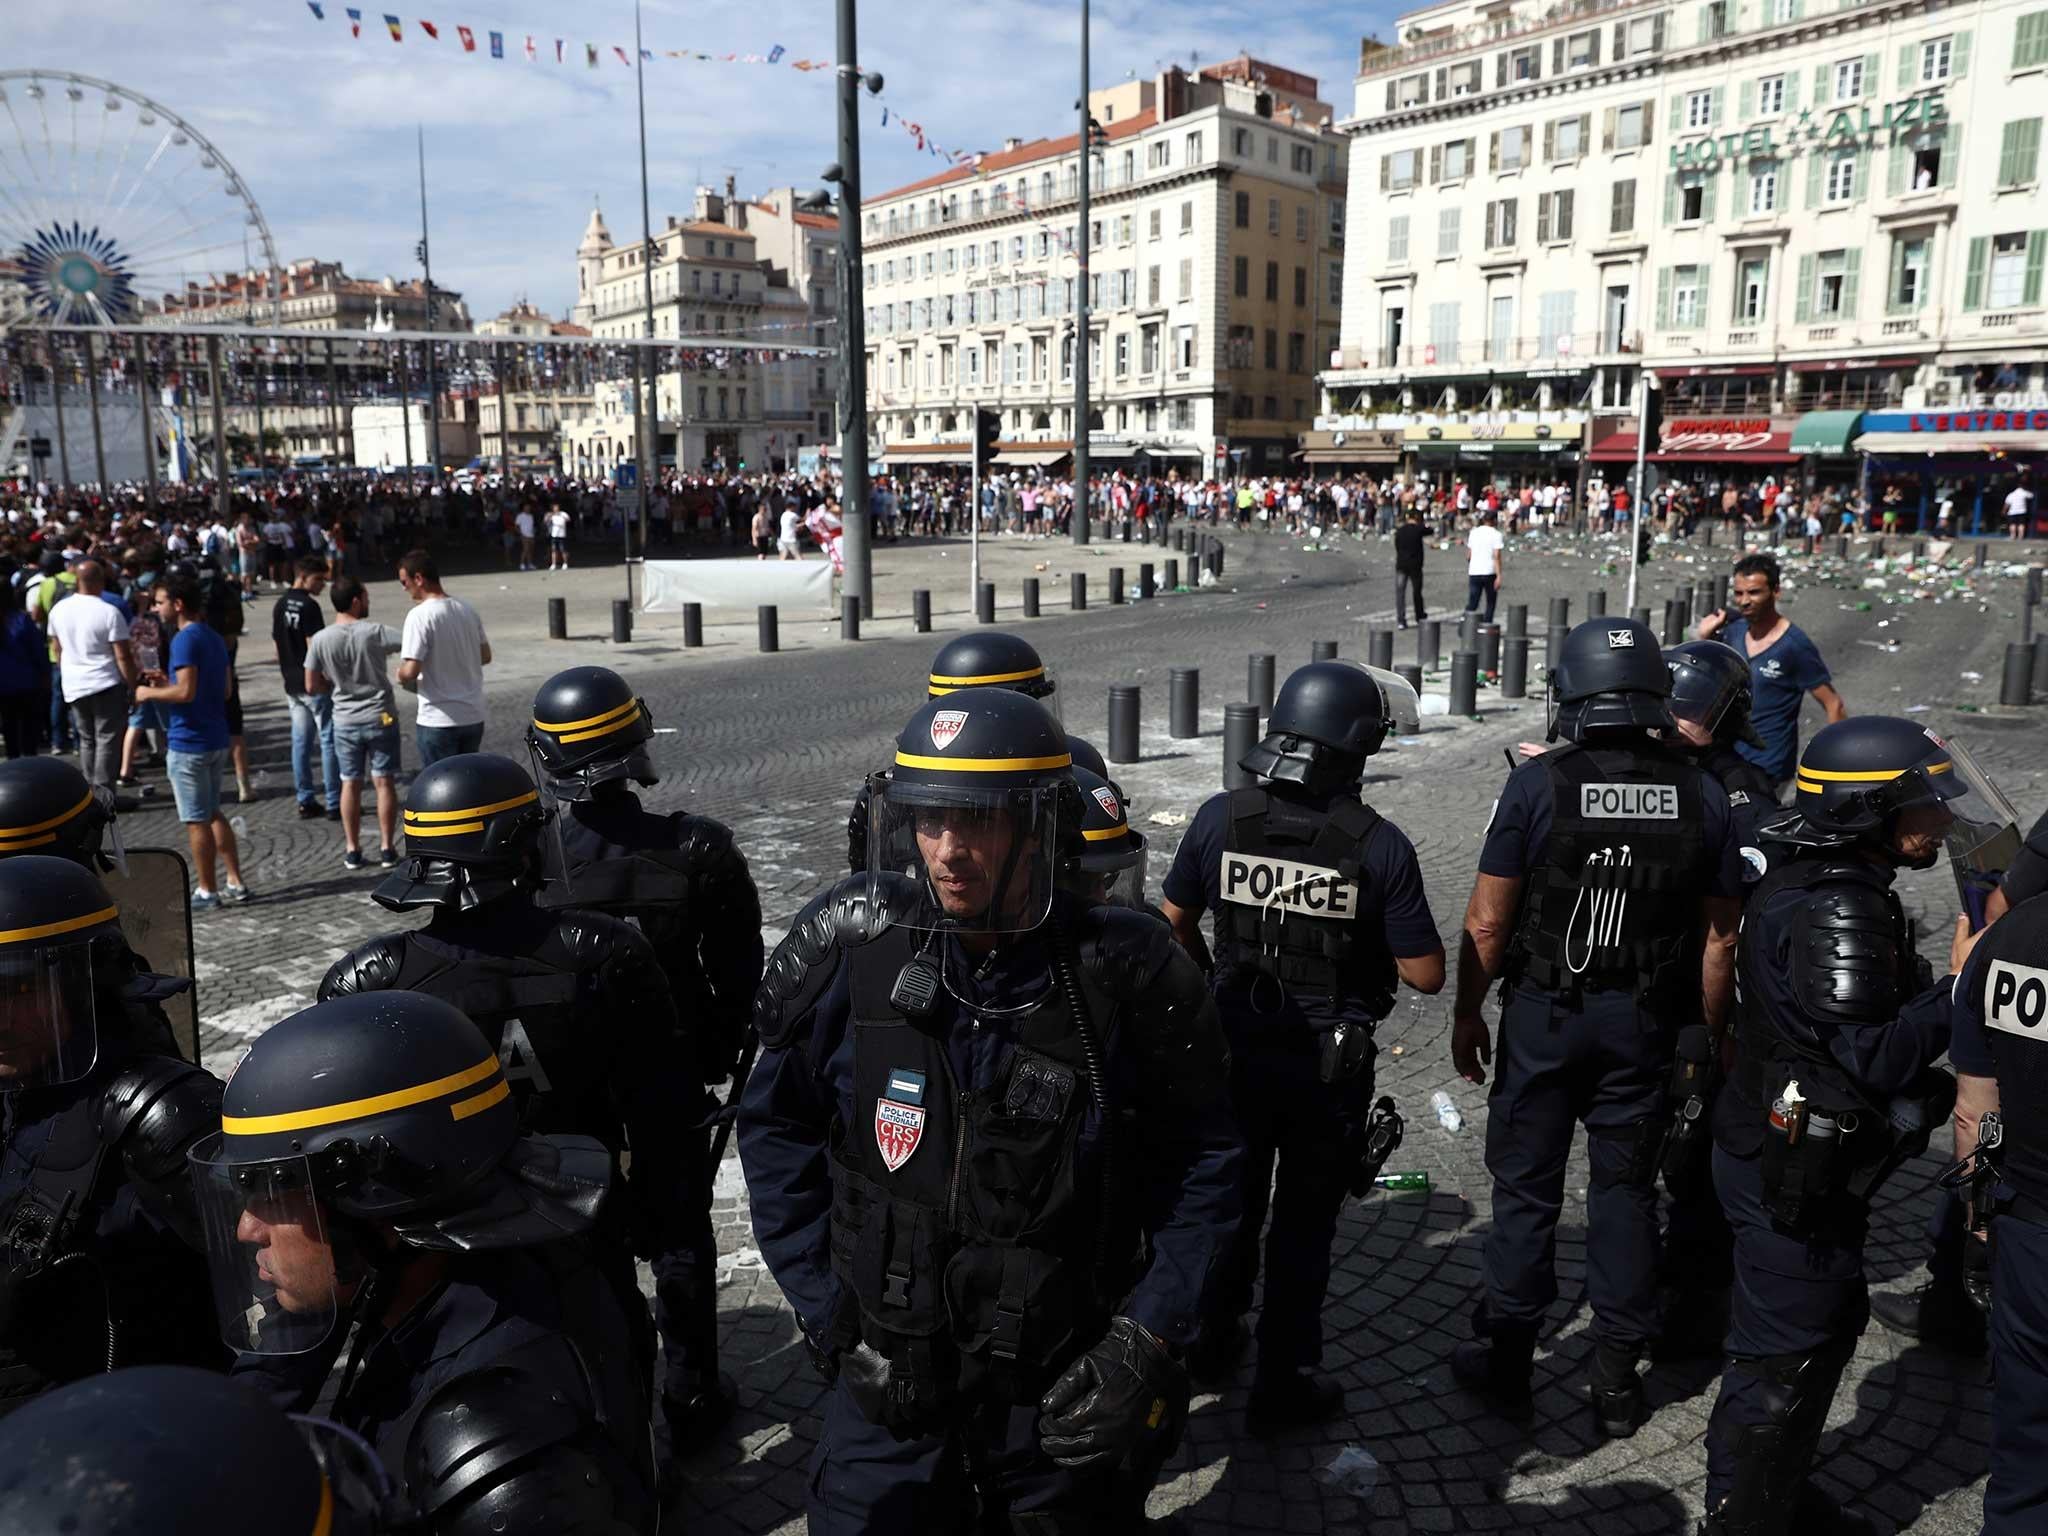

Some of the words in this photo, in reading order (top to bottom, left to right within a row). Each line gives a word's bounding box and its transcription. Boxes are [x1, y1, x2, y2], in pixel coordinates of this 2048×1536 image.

[1670, 127, 1780, 167] HOTEL
[934, 721, 958, 731] CRS
[1586, 788, 1674, 815] POLICE
[1227, 860, 1351, 912] POLICE
[1992, 969, 2047, 1029] PO
[880, 1111, 919, 1128] NATIONALE
[884, 1106, 917, 1120] POLICE
[880, 1121, 915, 1143] CRS
